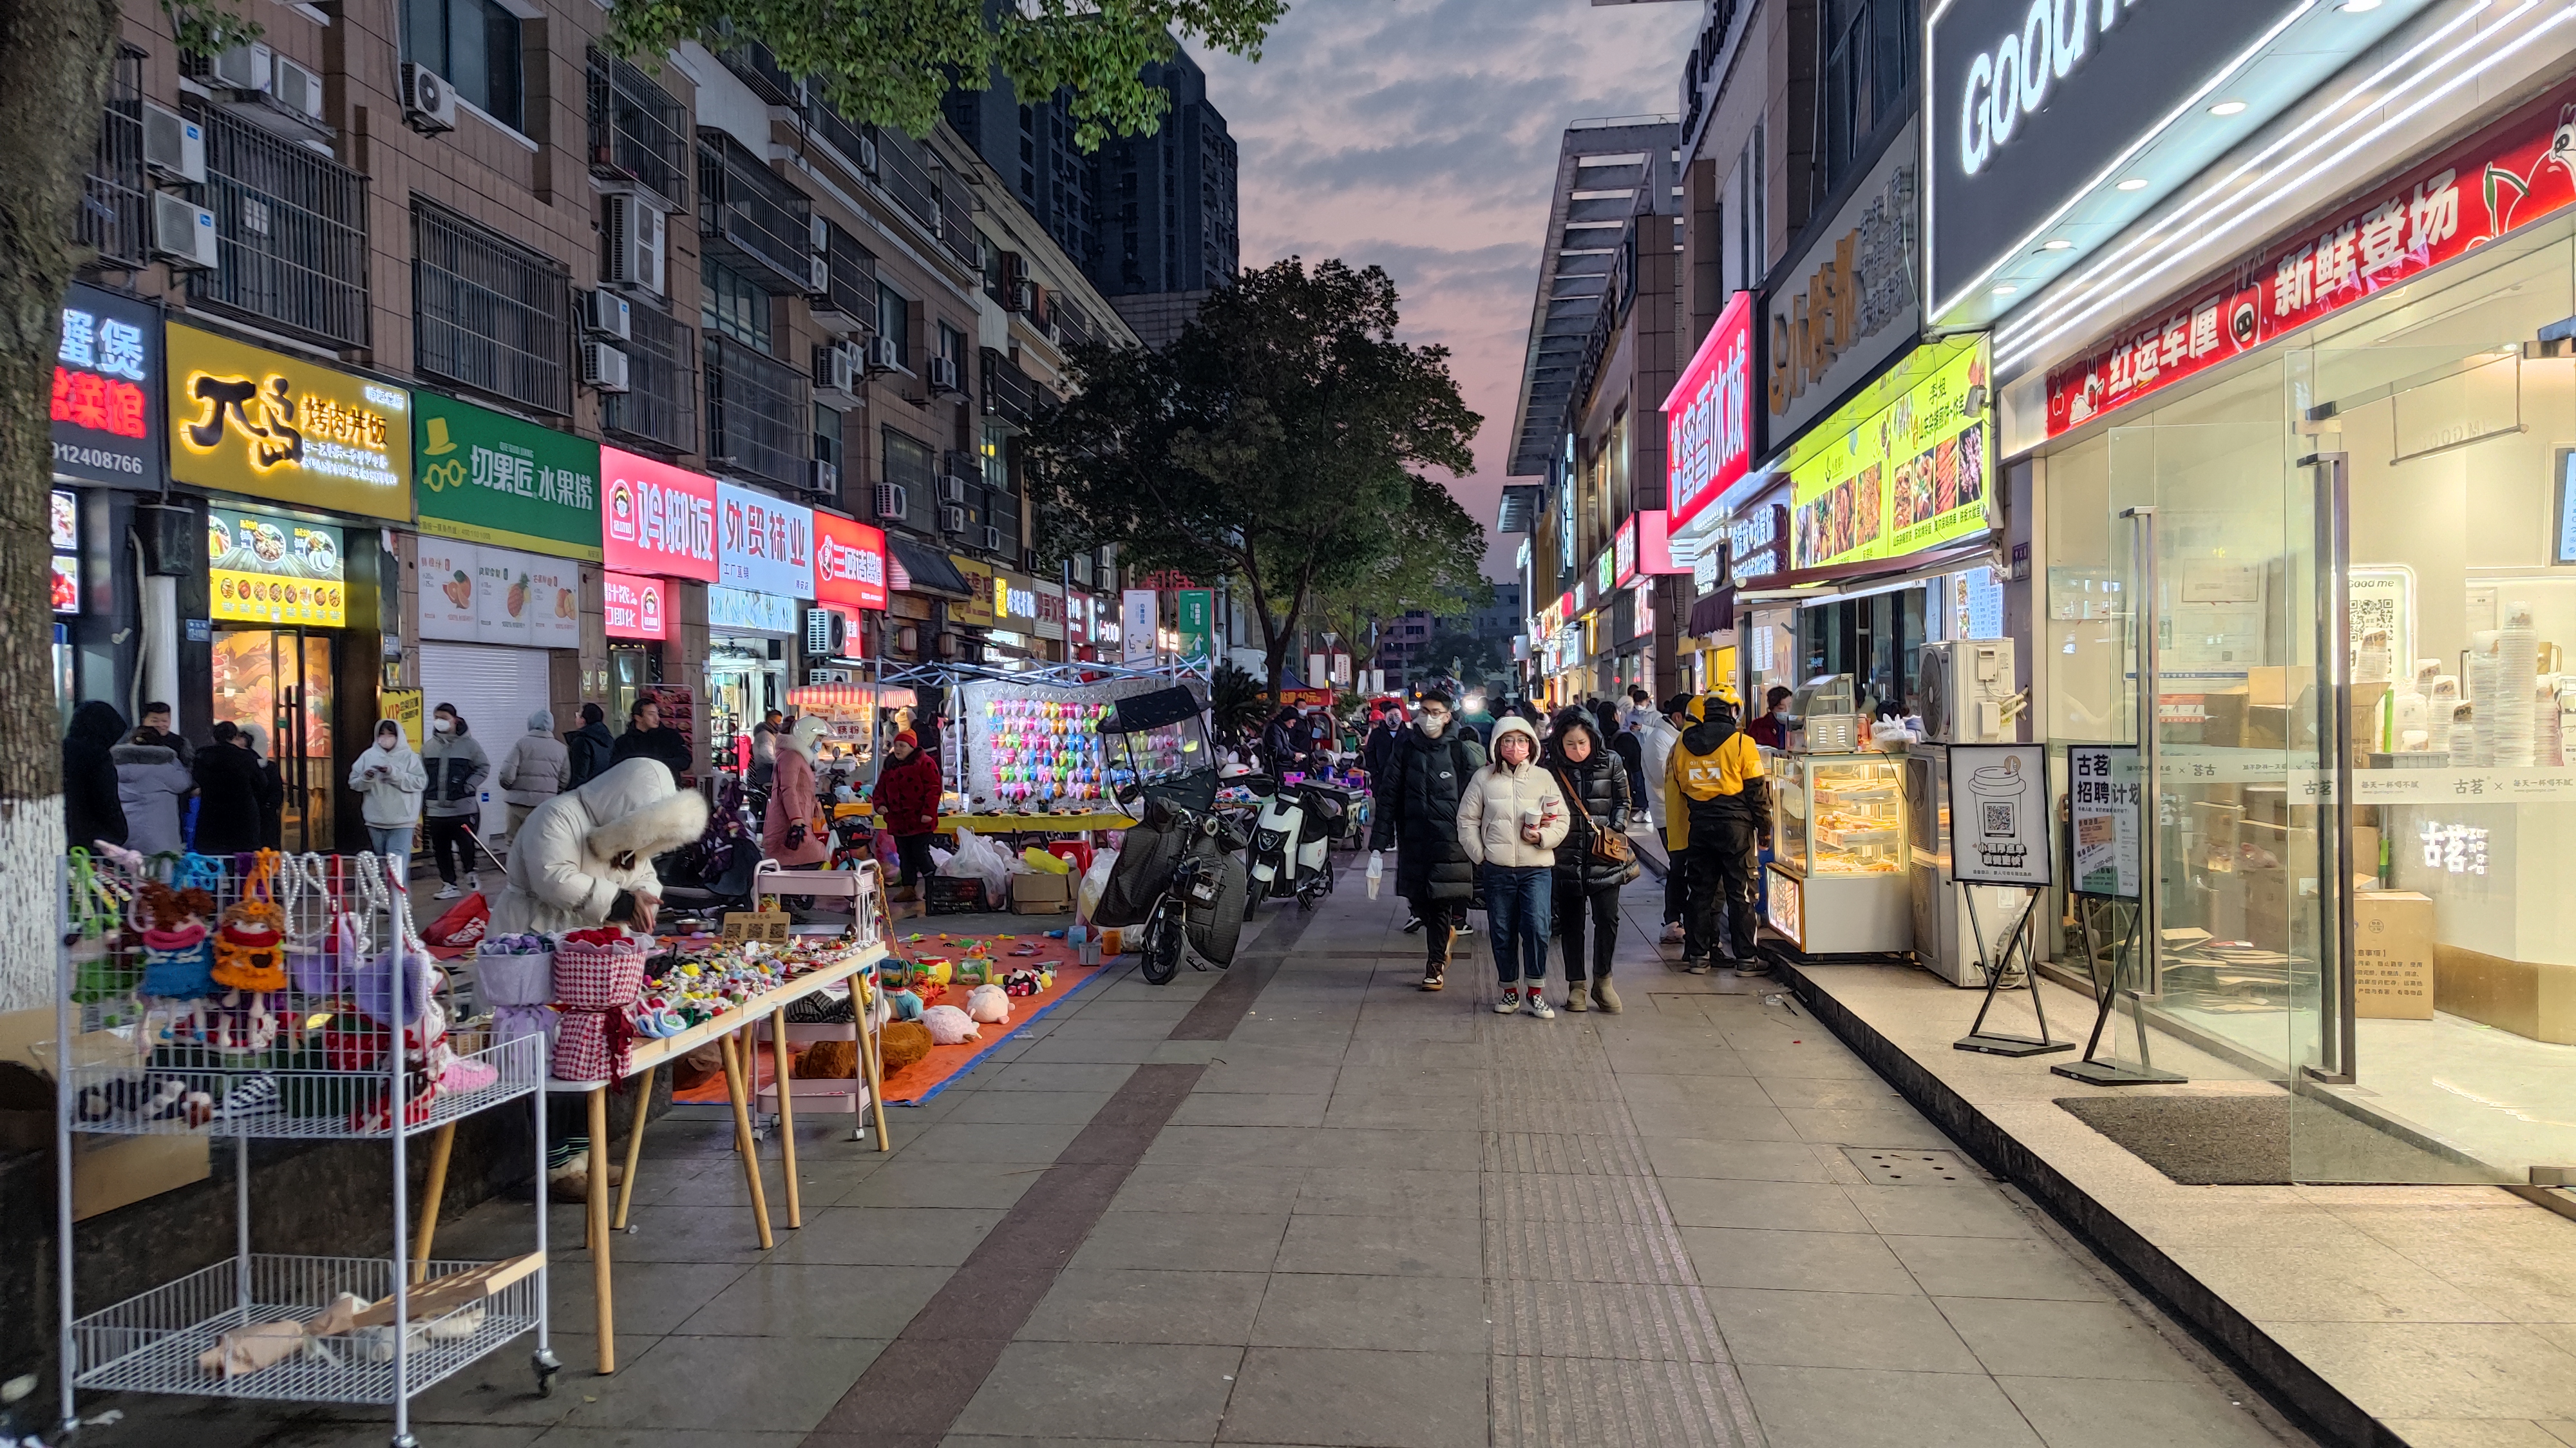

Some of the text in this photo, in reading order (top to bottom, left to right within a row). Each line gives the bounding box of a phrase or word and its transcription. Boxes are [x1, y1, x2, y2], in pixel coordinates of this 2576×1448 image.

[2274, 167, 2461, 317] 新鲜登场
[2108, 295, 2220, 396] 红运车厘
[1681, 328, 1745, 508] 蜜雪冰城
[637, 481, 713, 562] 鸡脚饭
[725, 498, 806, 567] 外贸袜业
[724, 562, 750, 580] 工厂直销
[2376, 580, 2395, 588] me
[384, 703, 401, 721] VIP
[2077, 754, 2109, 776] 古茗
[2077, 781, 2141, 805] 招聘计划
[2302, 779, 2334, 796] 古茗
[2452, 778, 2485, 795] 古茗
[2420, 821, 2468, 873] 古茗
